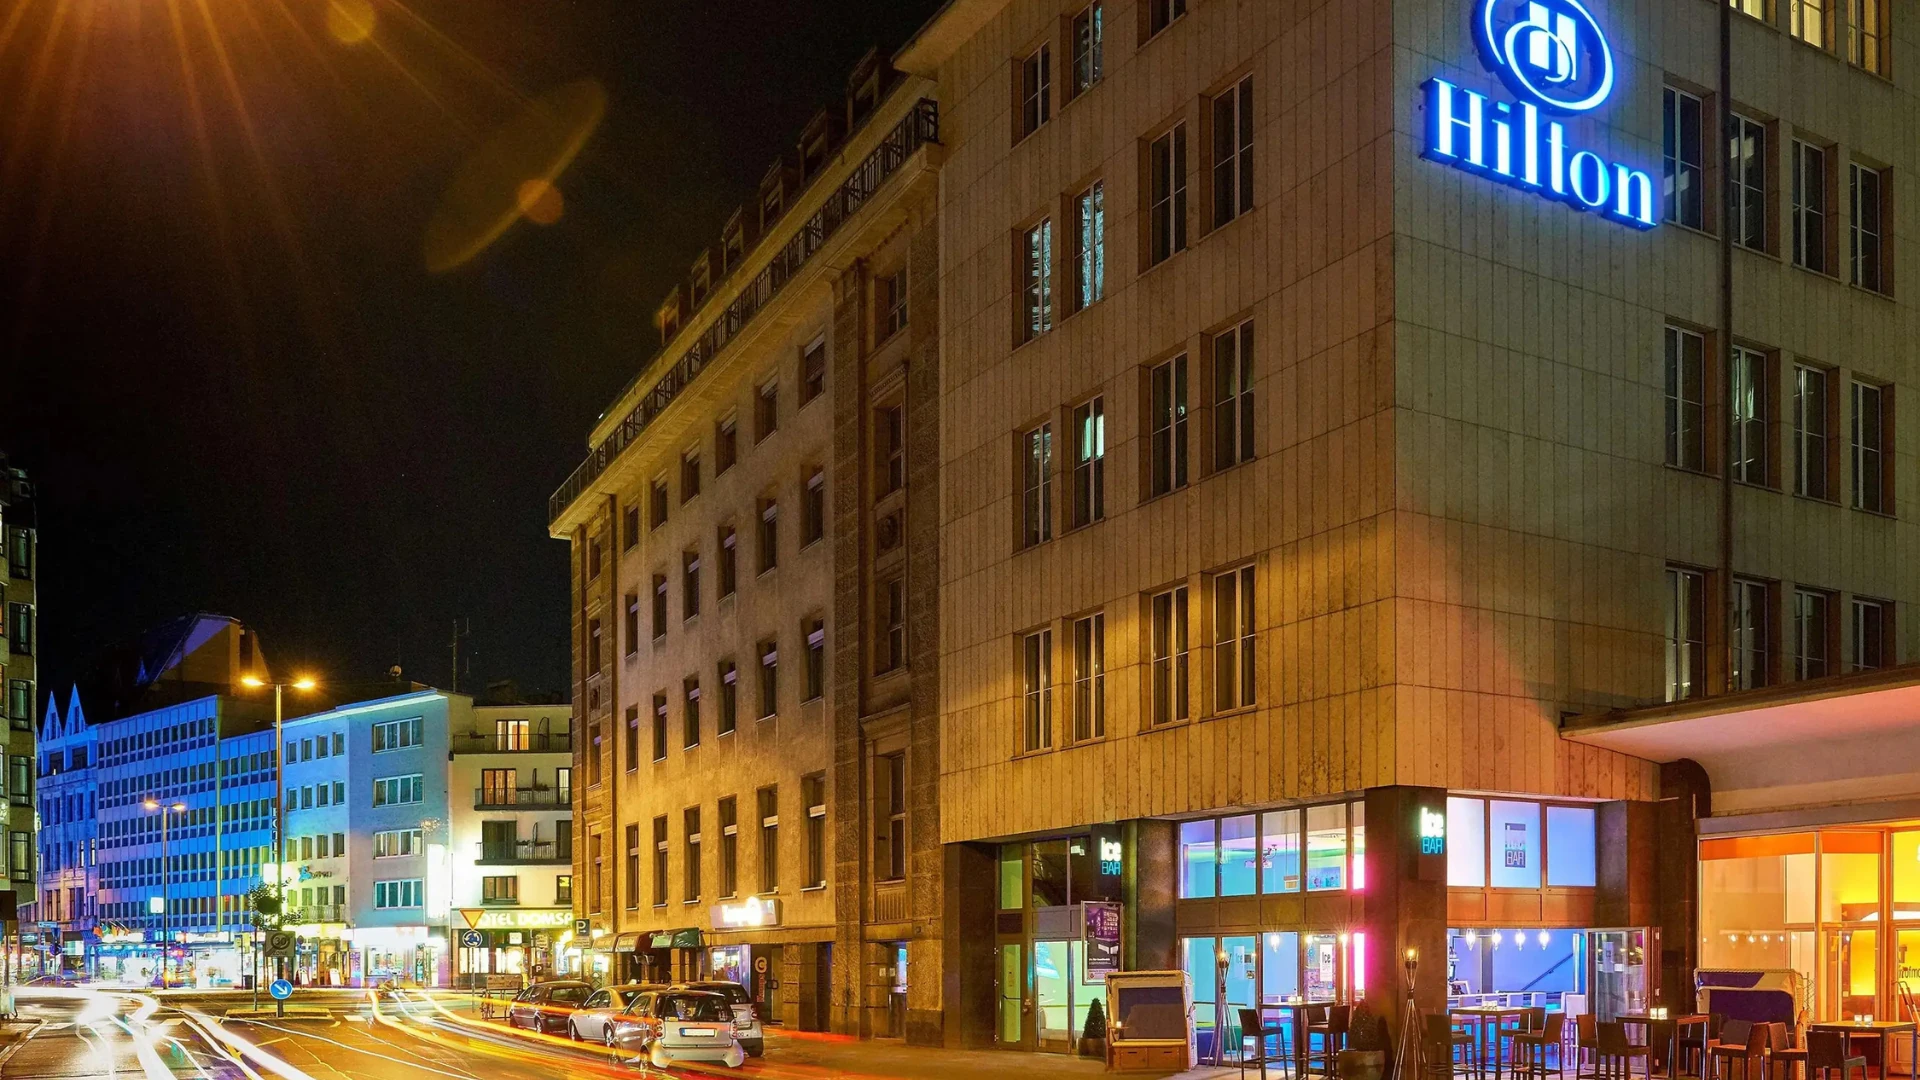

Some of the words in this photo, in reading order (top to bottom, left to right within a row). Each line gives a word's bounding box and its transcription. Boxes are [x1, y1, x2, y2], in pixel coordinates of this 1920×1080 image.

[1429, 76, 1657, 229] Hilton
[1422, 837, 1443, 854] BAR
[1506, 850, 1525, 866] BAR
[1101, 861, 1121, 875] BAR
[479, 912, 514, 926] OTEL
[575, 920, 586, 934] P
[274, 936, 287, 946] 30
[535, 965, 542, 973] P
